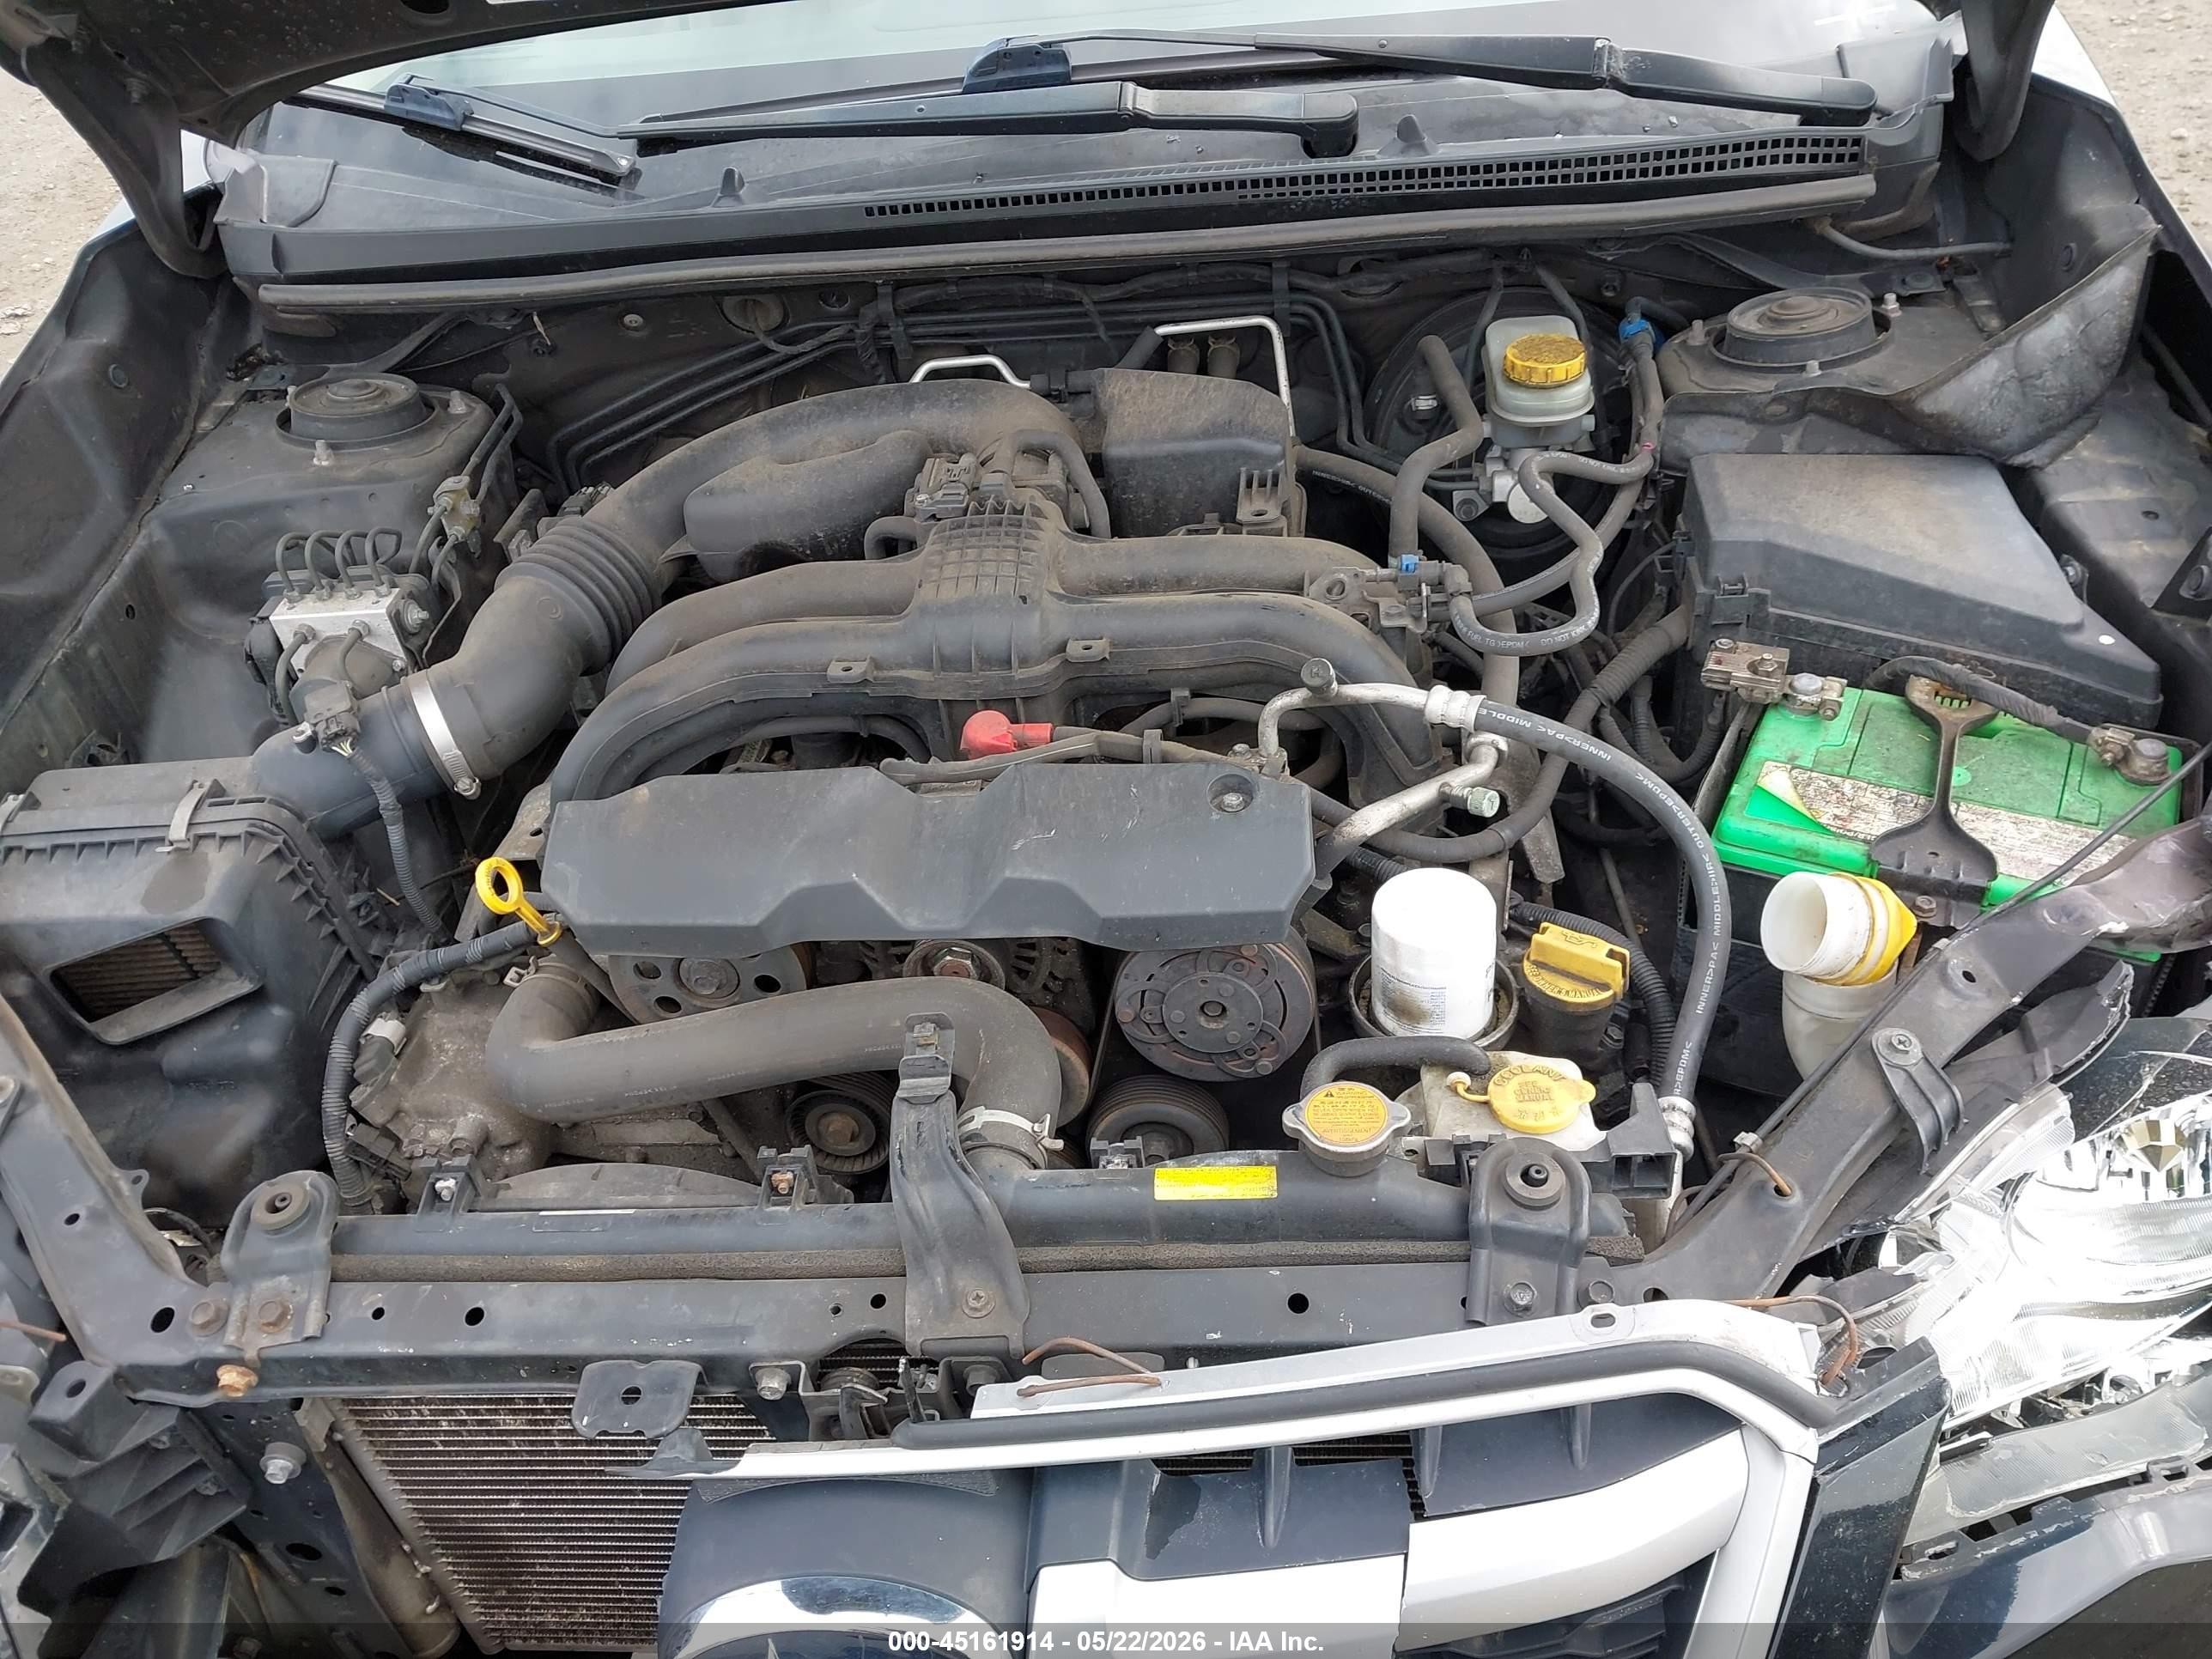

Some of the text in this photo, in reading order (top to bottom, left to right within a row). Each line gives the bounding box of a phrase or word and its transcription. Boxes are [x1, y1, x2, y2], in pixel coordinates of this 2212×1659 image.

[1468, 630, 1482, 643] FUEL
[1477, 707, 1532, 728] MIDDLE
[1528, 964, 1540, 976] SEE
[1568, 988, 1603, 999] MANUAL
[1494, 1065, 1566, 1086] COOLANT
